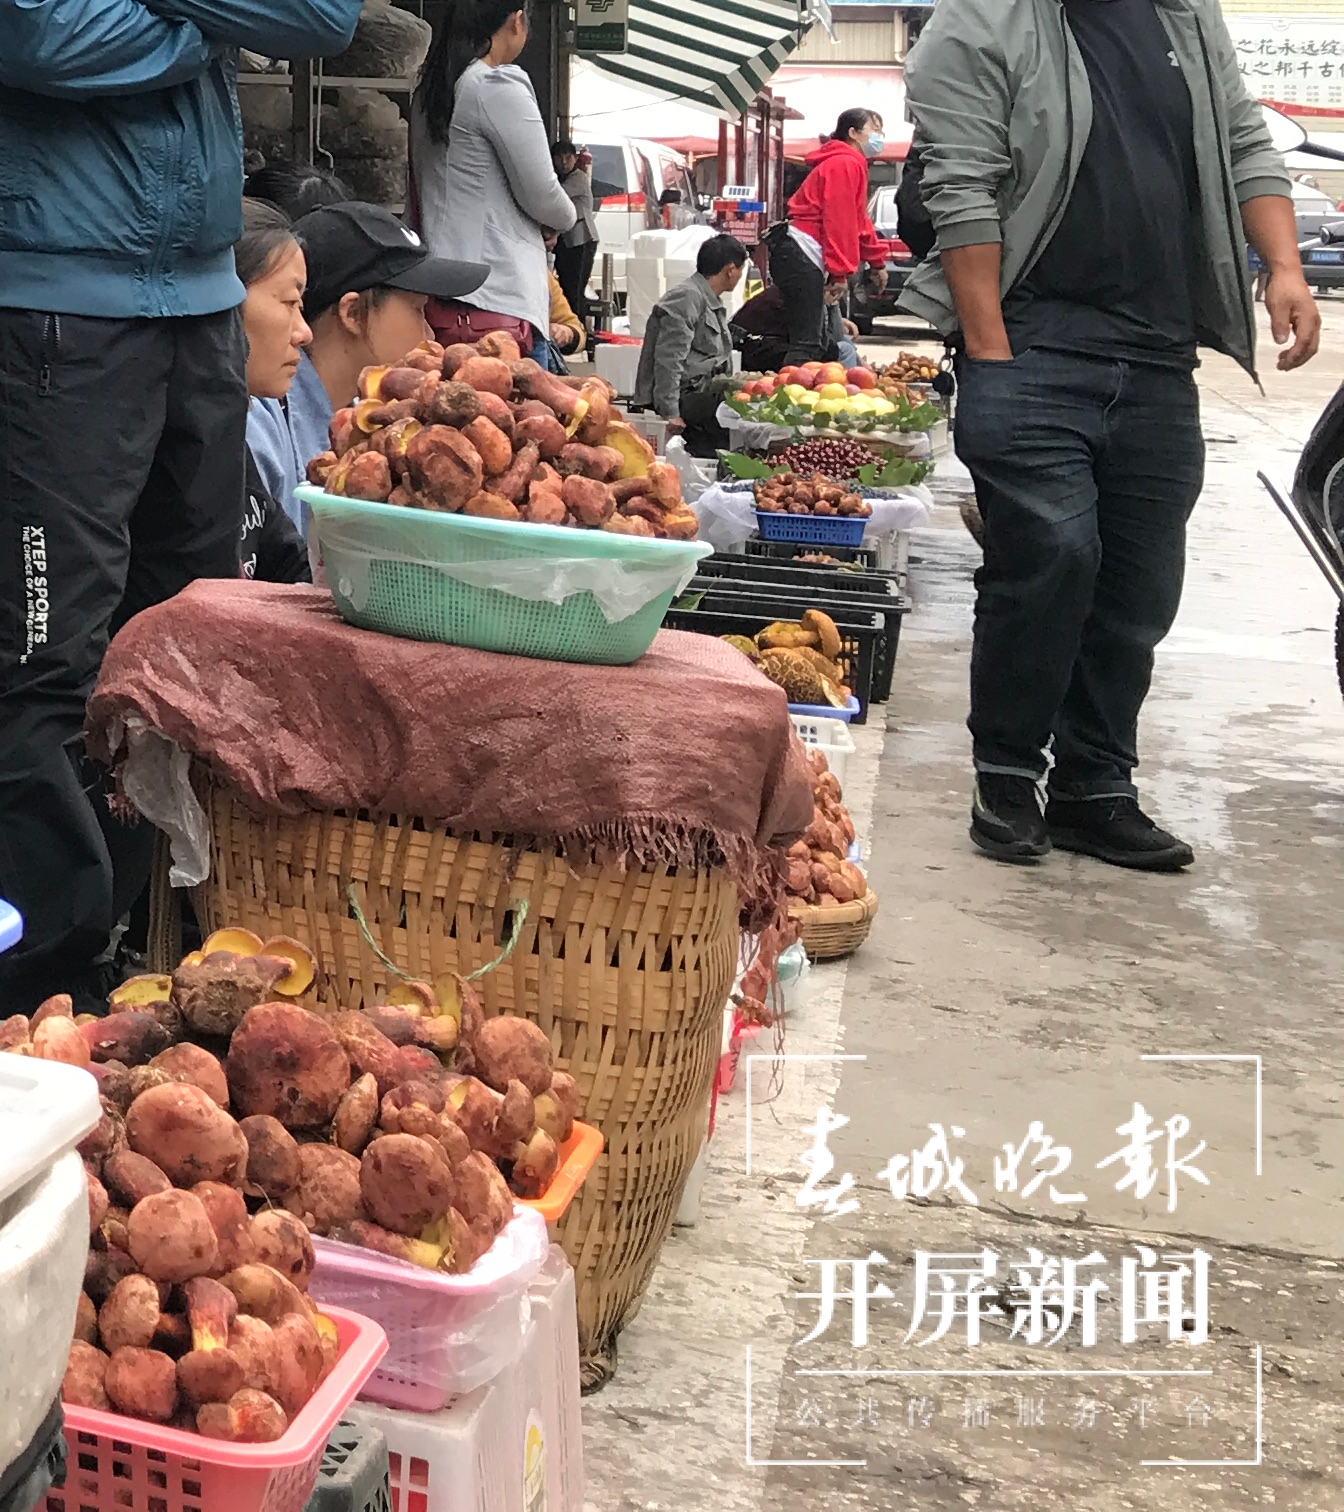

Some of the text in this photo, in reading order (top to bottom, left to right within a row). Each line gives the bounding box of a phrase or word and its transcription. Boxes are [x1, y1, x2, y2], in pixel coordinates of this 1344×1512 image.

[22, 525, 30, 543] THE
[23, 544, 34, 576] CHOICE
[30, 525, 50, 644] XTEP SPORTS
[26, 599, 35, 619] NEW
